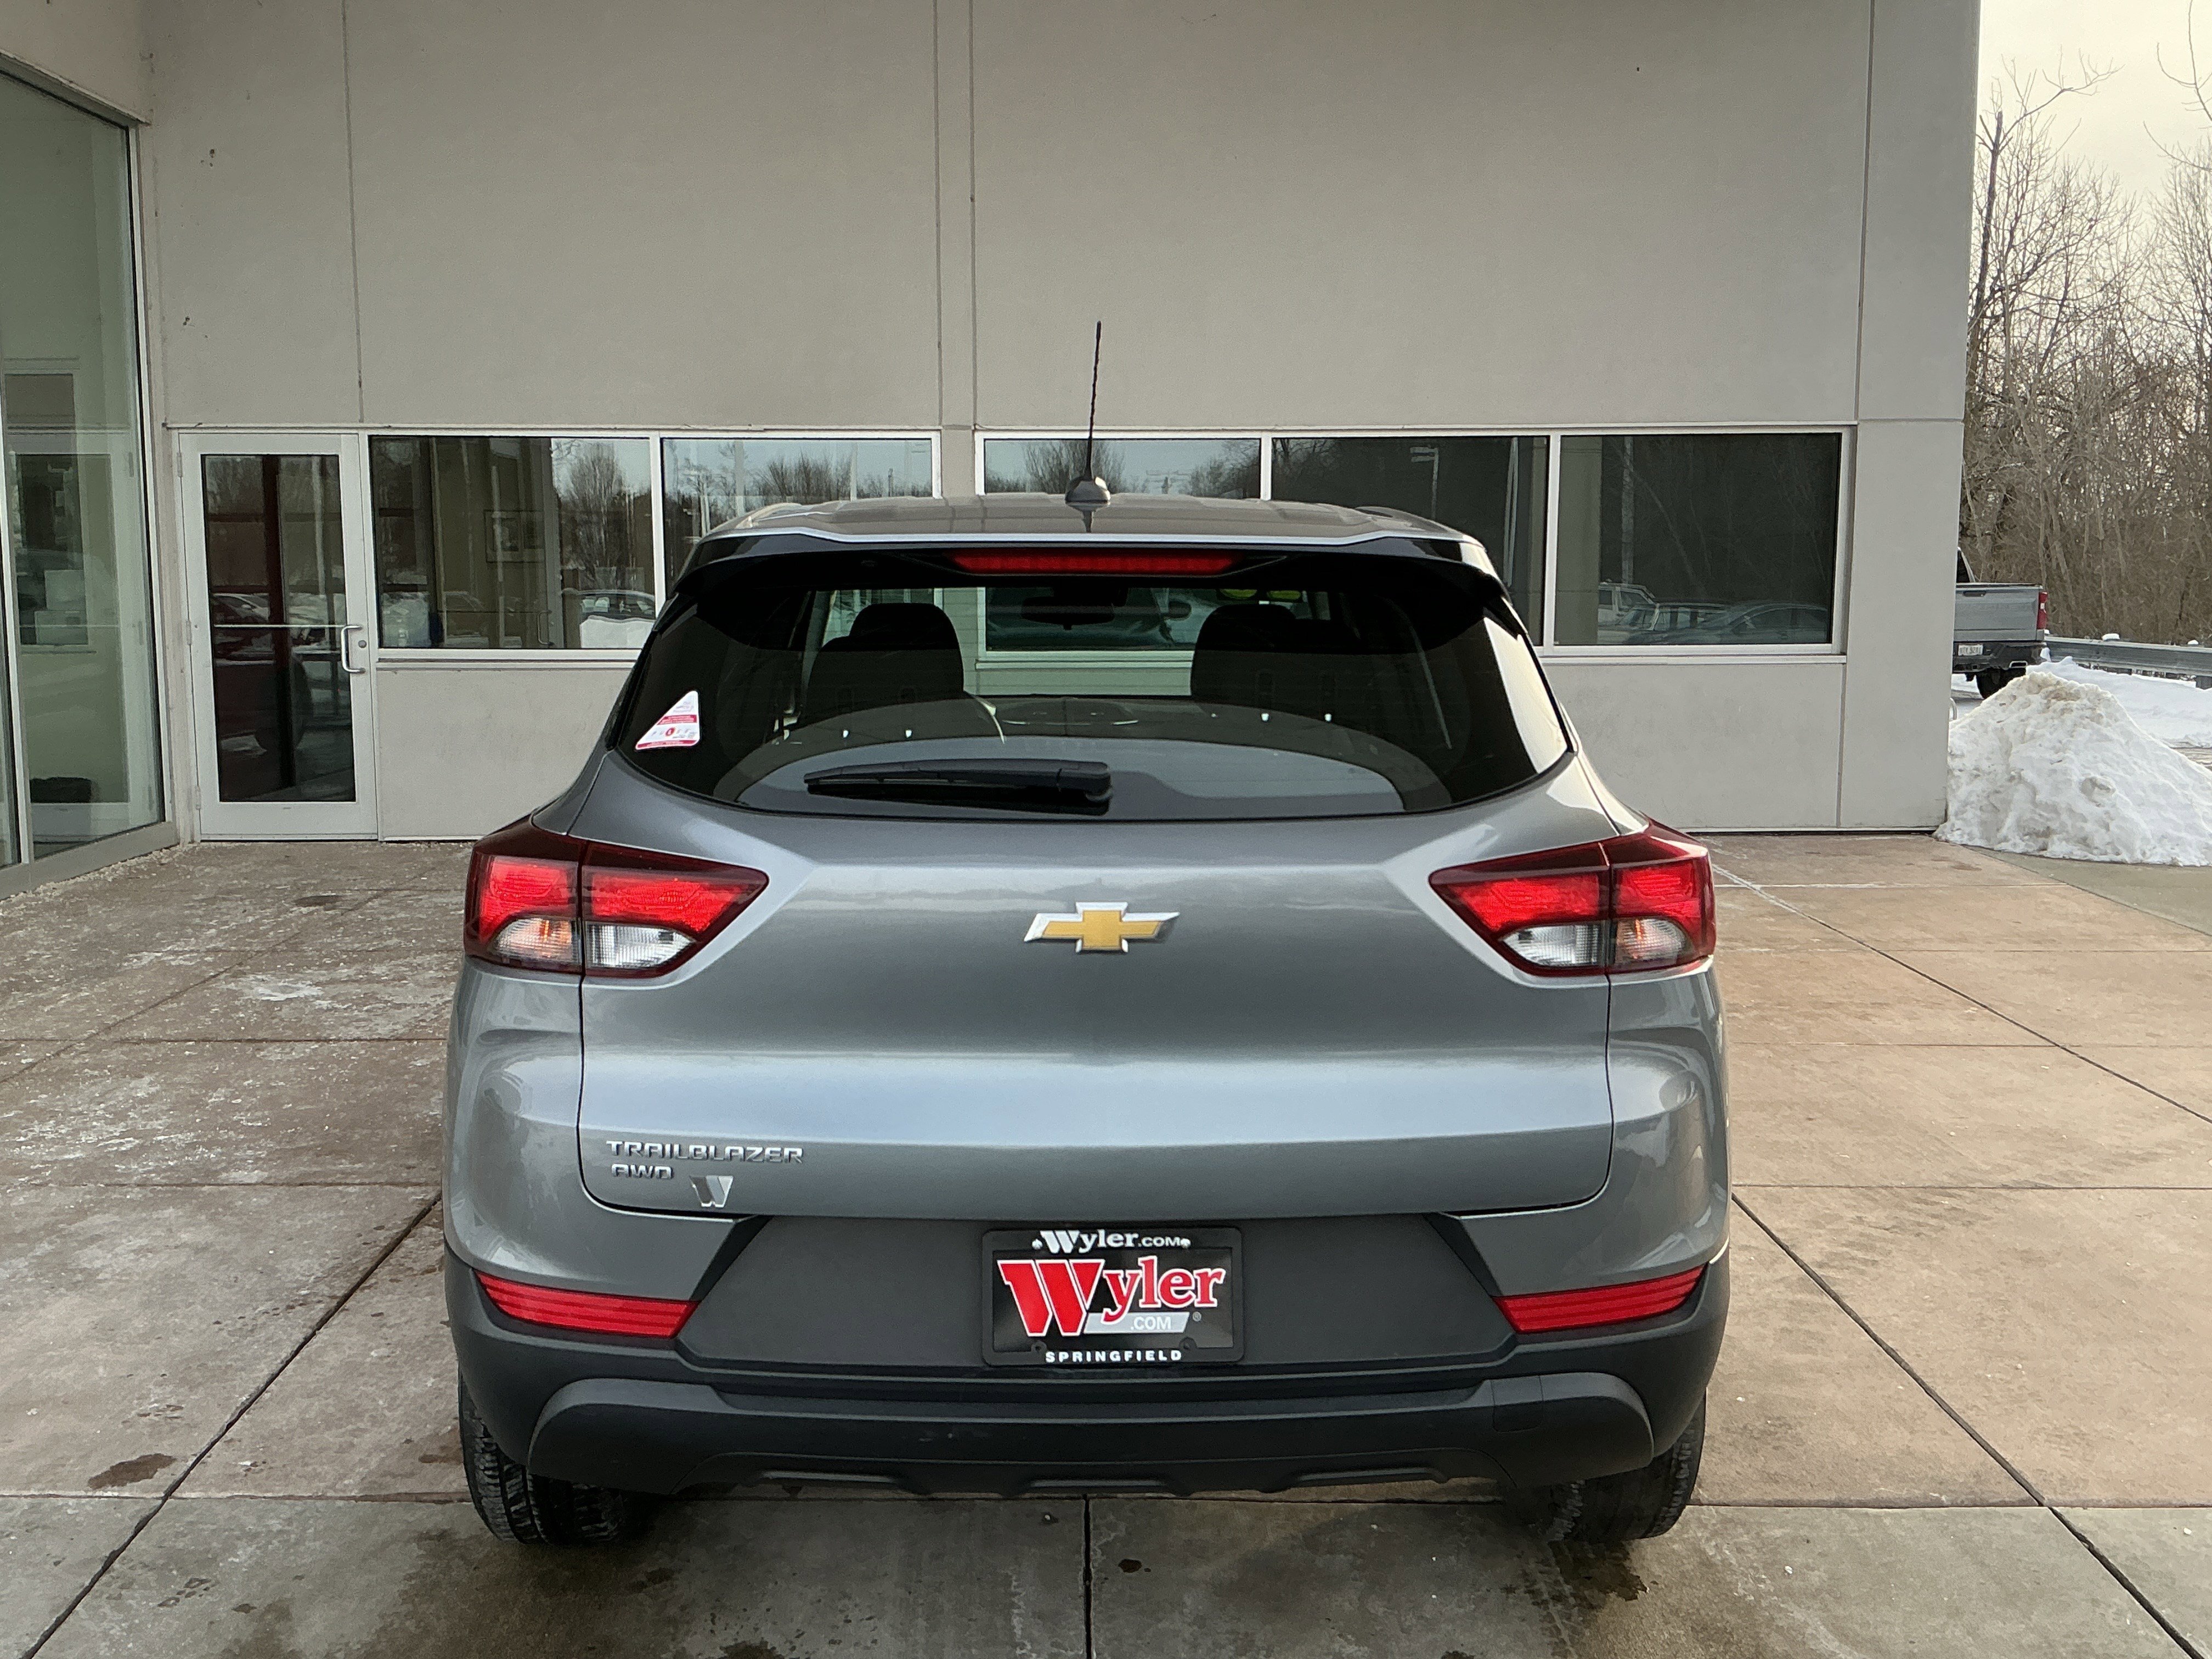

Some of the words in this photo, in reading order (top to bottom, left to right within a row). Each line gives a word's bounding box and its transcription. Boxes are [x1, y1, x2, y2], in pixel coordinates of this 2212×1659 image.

[606, 1141, 803, 1164] TRAILBLAZER
[611, 1164, 672, 1179] AWD
[997, 1255, 1226, 1337] Wyler
[1131, 1317, 1171, 1330] .COM
[1046, 1350, 1182, 1363] SPRINGFIELD
